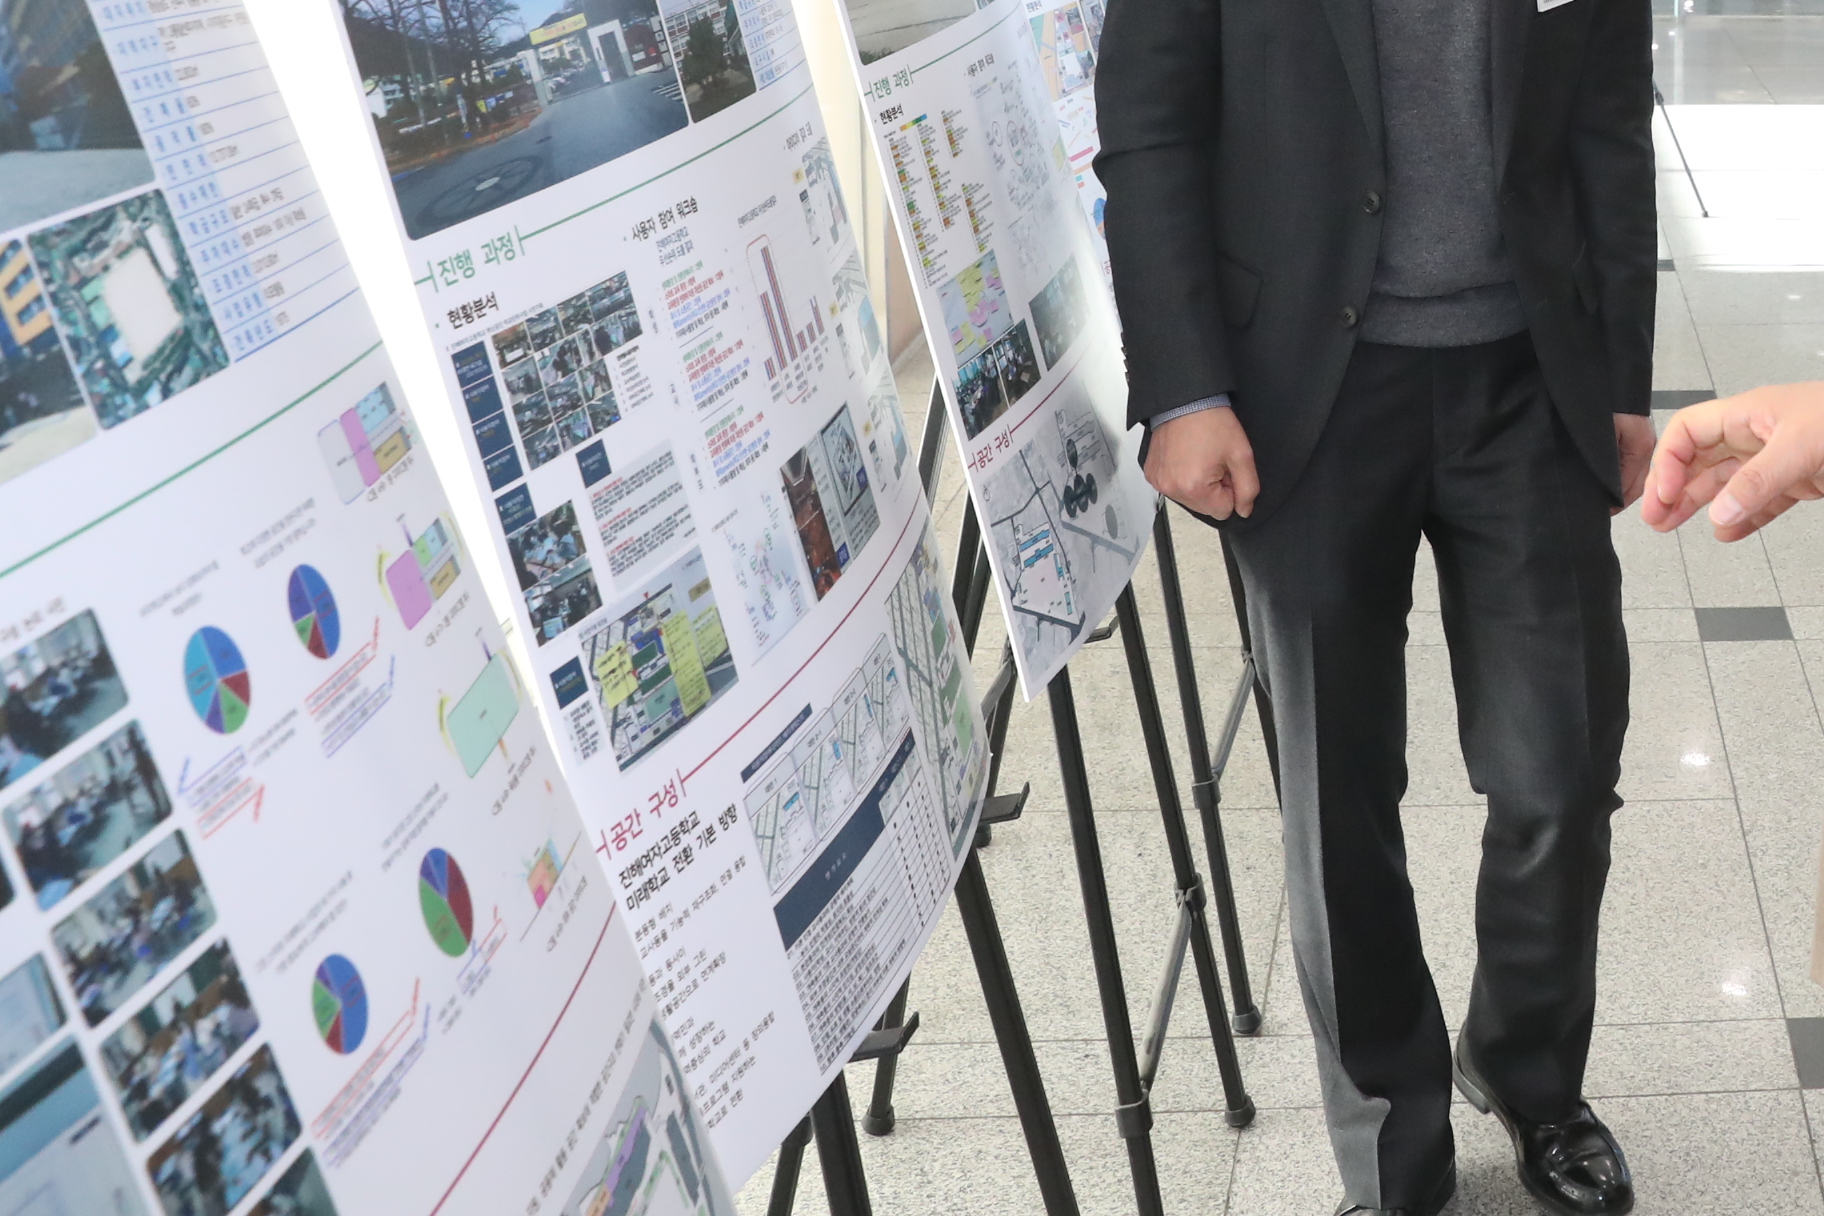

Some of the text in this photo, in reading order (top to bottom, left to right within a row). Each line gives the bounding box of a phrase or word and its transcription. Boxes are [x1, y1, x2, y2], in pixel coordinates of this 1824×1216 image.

[873, 69, 911, 98] 진행 과정
[879, 104, 904, 125] 현황분석
[632, 195, 698, 242] 사용자 참여 워크숍
[437, 232, 516, 287] 진행 과정
[447, 291, 499, 330] 현황분석
[976, 431, 1010, 471] 공간 구성
[610, 778, 679, 851] 공간 구성
[618, 810, 700, 889] 진해여자고등학교
[626, 802, 738, 911] 미래학교 전환 기본 방향
